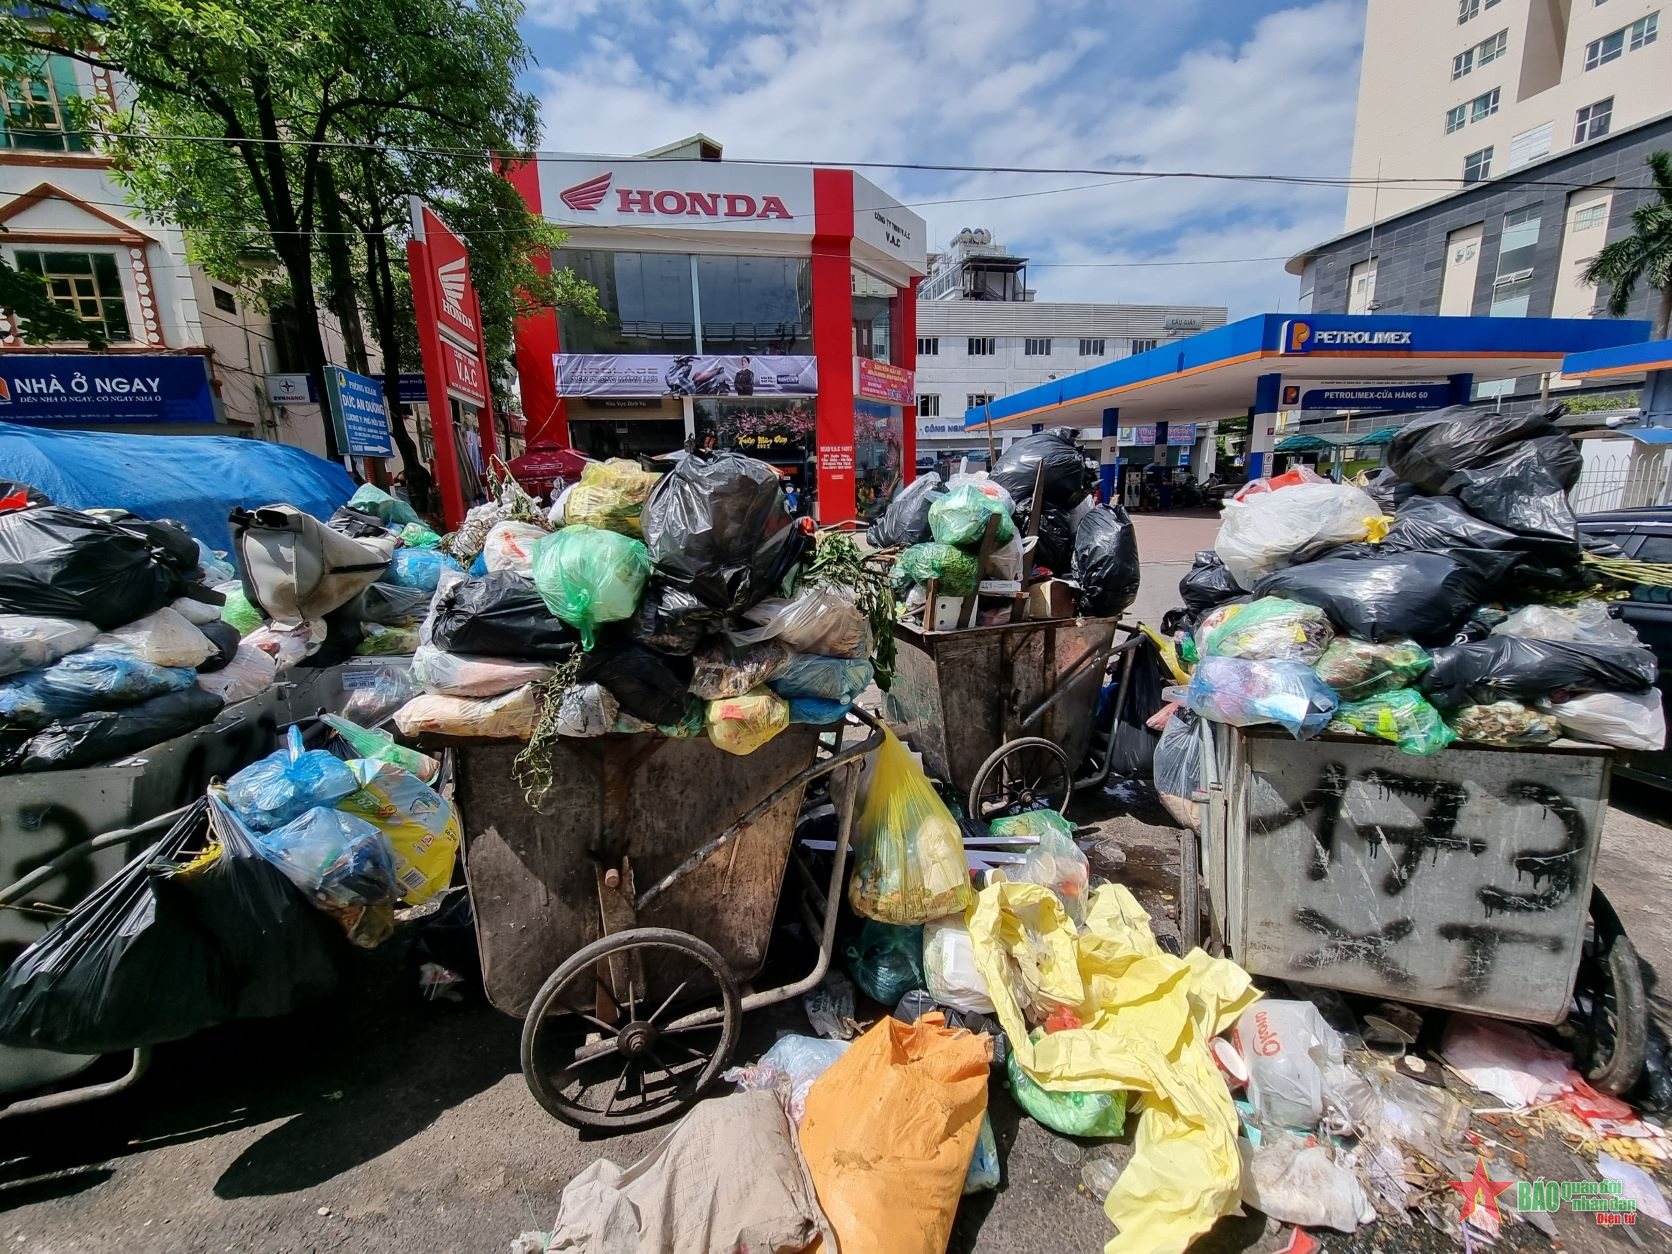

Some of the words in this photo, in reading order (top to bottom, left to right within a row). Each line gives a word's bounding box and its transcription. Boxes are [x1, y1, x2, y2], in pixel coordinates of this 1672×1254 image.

[616, 188, 793, 219] HONDA
[441, 298, 476, 333] HONDA
[1313, 329, 1412, 345] PETROLIMEX
[14, 373, 66, 394] NHÀ
[70, 371, 89, 394] Ở
[94, 377, 160, 393] NGAY
[455, 359, 478, 388] V.A.C
[1394, 390, 1417, 399] HÀNG
[1418, 391, 1429, 399] 60
[924, 424, 946, 433] CÔNG
